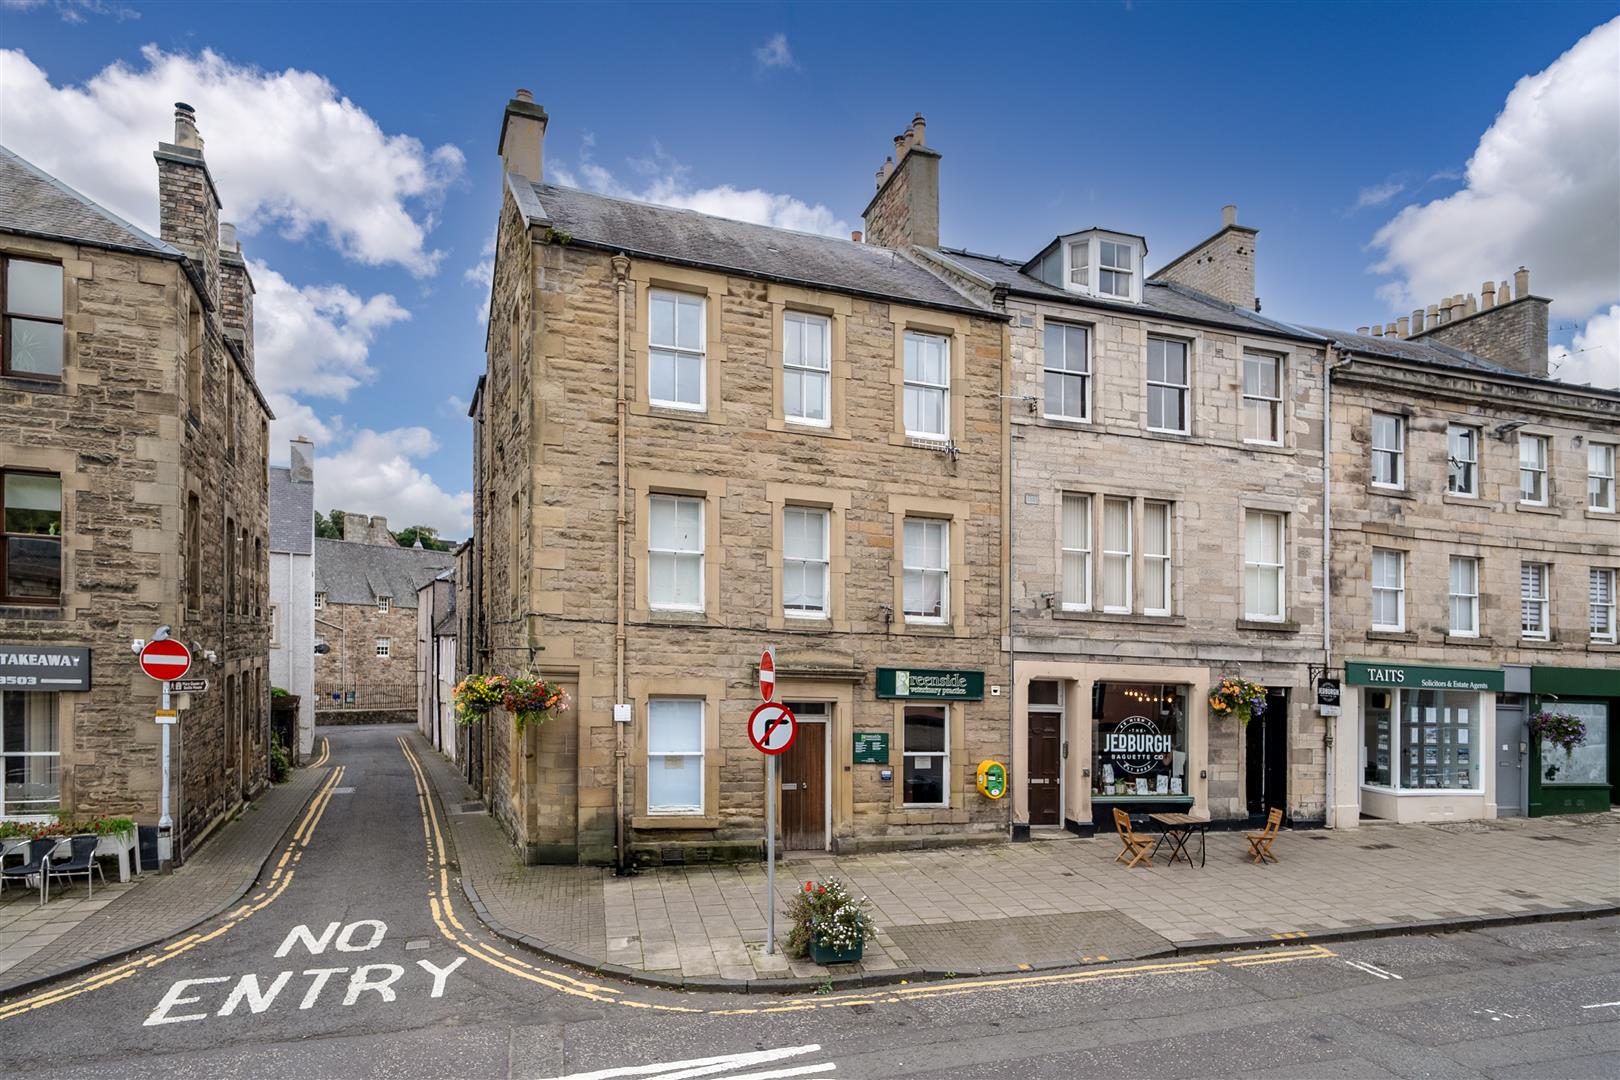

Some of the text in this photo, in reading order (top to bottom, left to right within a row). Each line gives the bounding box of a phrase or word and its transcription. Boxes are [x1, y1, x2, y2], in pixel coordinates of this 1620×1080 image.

[0, 653, 80, 667] TAKEAWAY
[1367, 668, 1405, 682] TAITS
[1421, 679, 1446, 688] Solicitors
[1453, 680, 1469, 688] Estate
[1469, 681, 1489, 690] Agents
[1103, 733, 1172, 753] JEDBURGH
[273, 919, 388, 958] NO
[142, 956, 468, 1027] ENTRY
